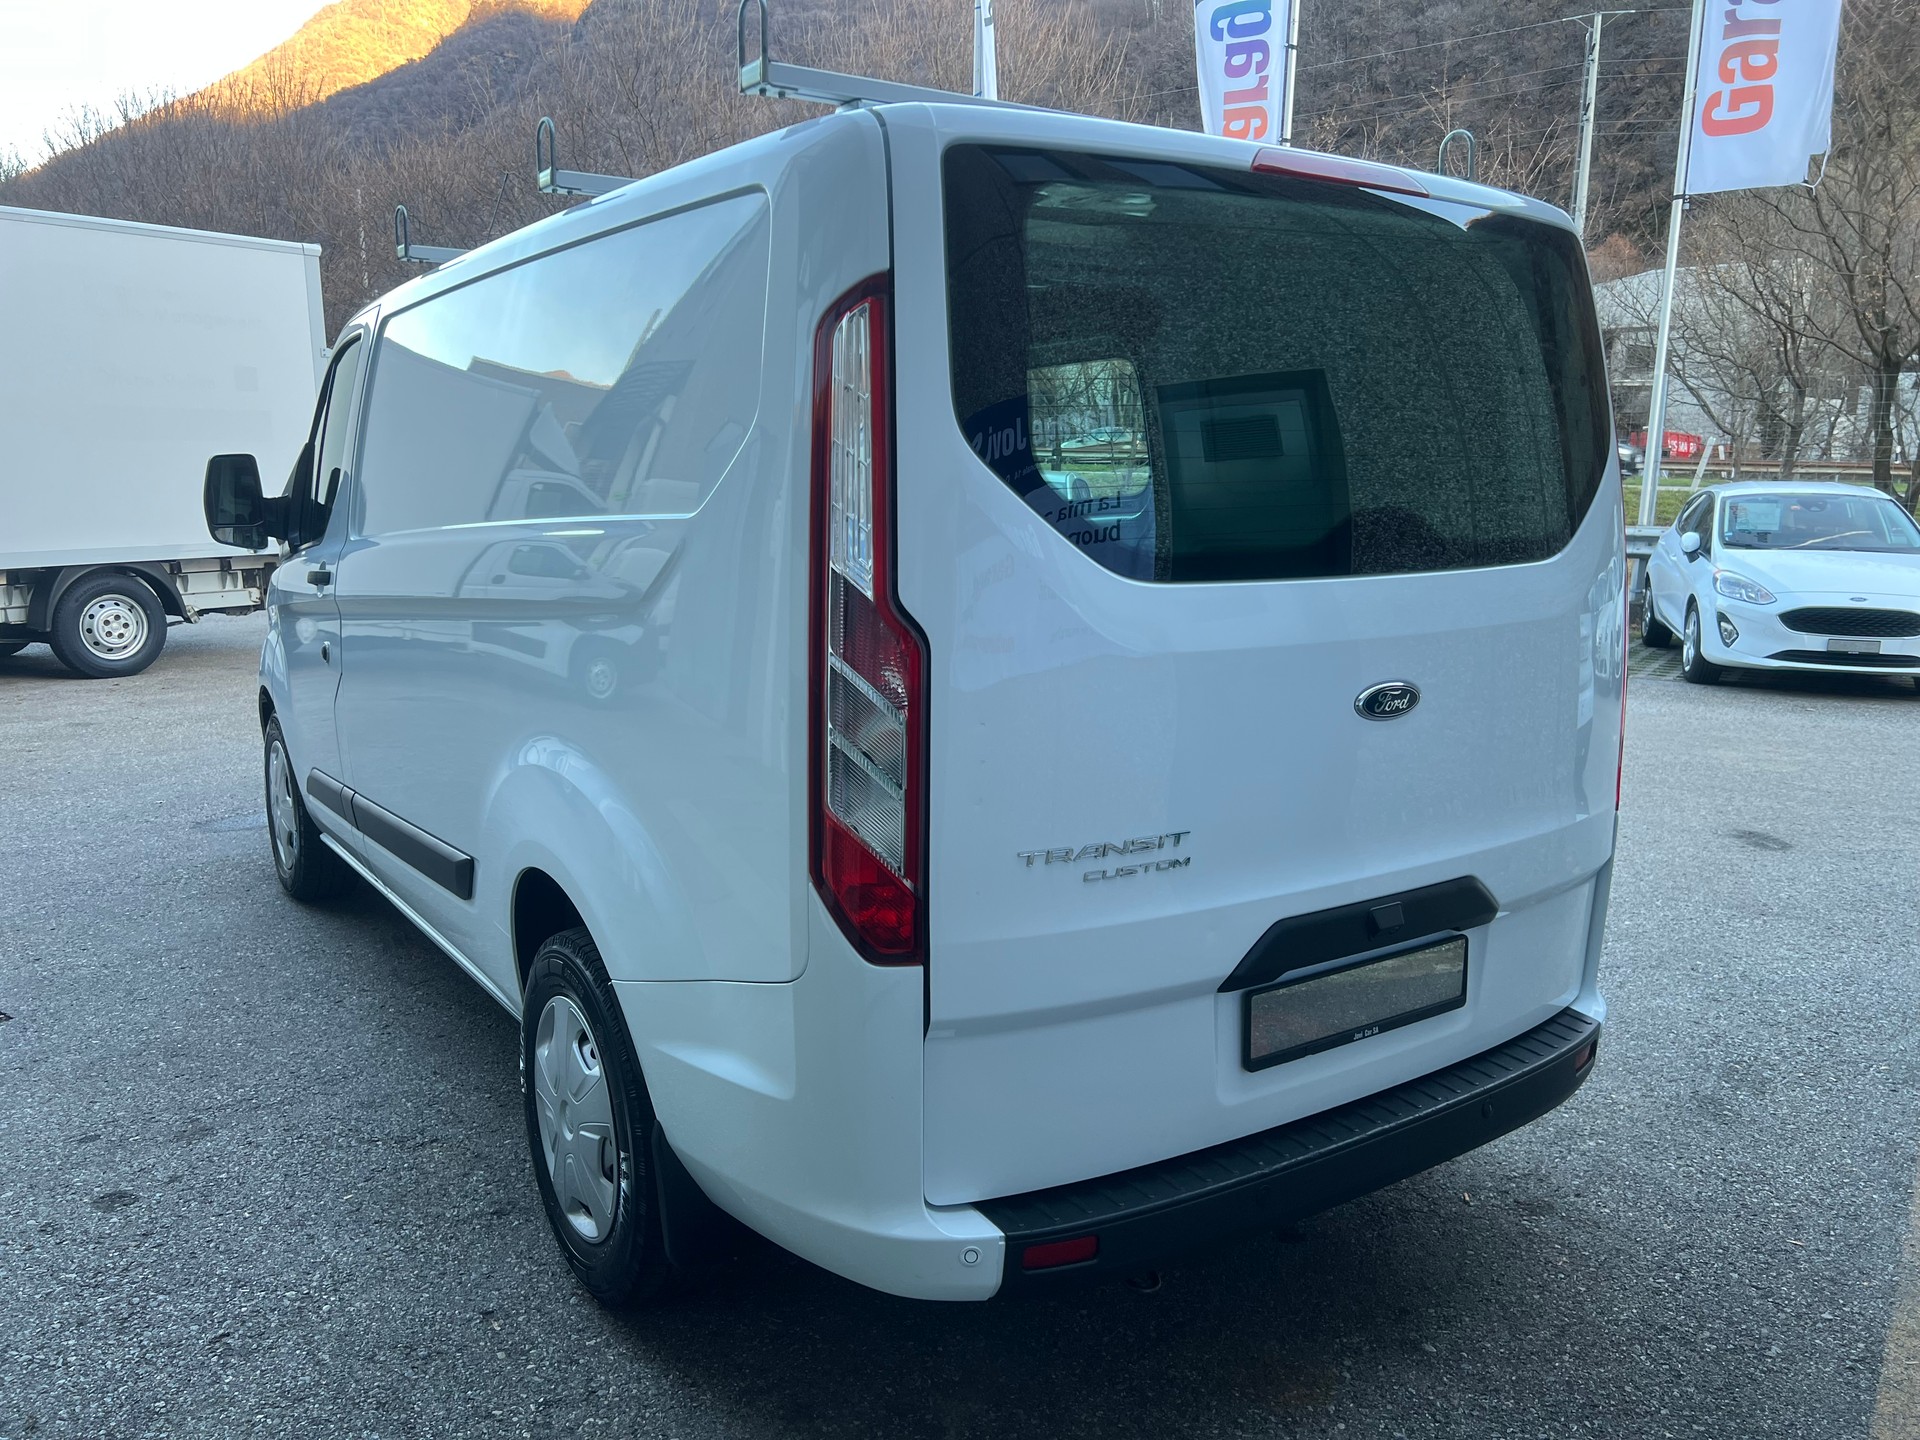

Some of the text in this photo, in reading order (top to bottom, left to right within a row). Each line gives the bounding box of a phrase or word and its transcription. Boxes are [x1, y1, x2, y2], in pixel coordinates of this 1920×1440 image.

[1702, 0, 1782, 137] Gar
[1374, 689, 1411, 713] Ford
[1017, 831, 1191, 867] TRANSIT
[1083, 856, 1191, 882] CUSTOM
